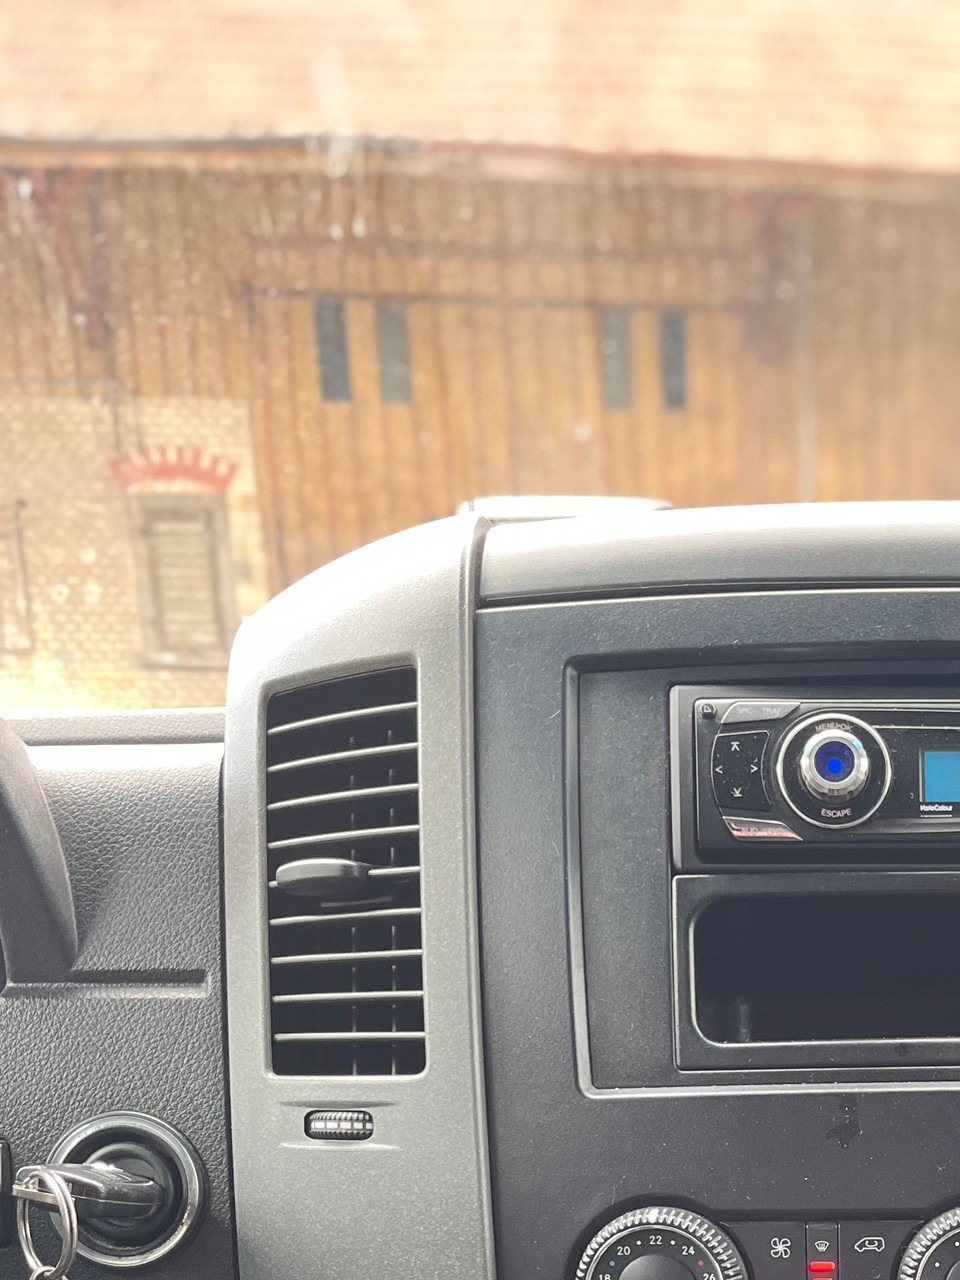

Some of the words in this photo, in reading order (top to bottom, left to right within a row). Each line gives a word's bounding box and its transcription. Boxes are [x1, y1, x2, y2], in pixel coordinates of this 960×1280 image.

[820, 808, 852, 818] ESCAPE
[919, 804, 953, 812] VarioColour
[649, 1235, 663, 1245] 22
[617, 1246, 631, 1256] 20
[681, 1245, 695, 1256] 24
